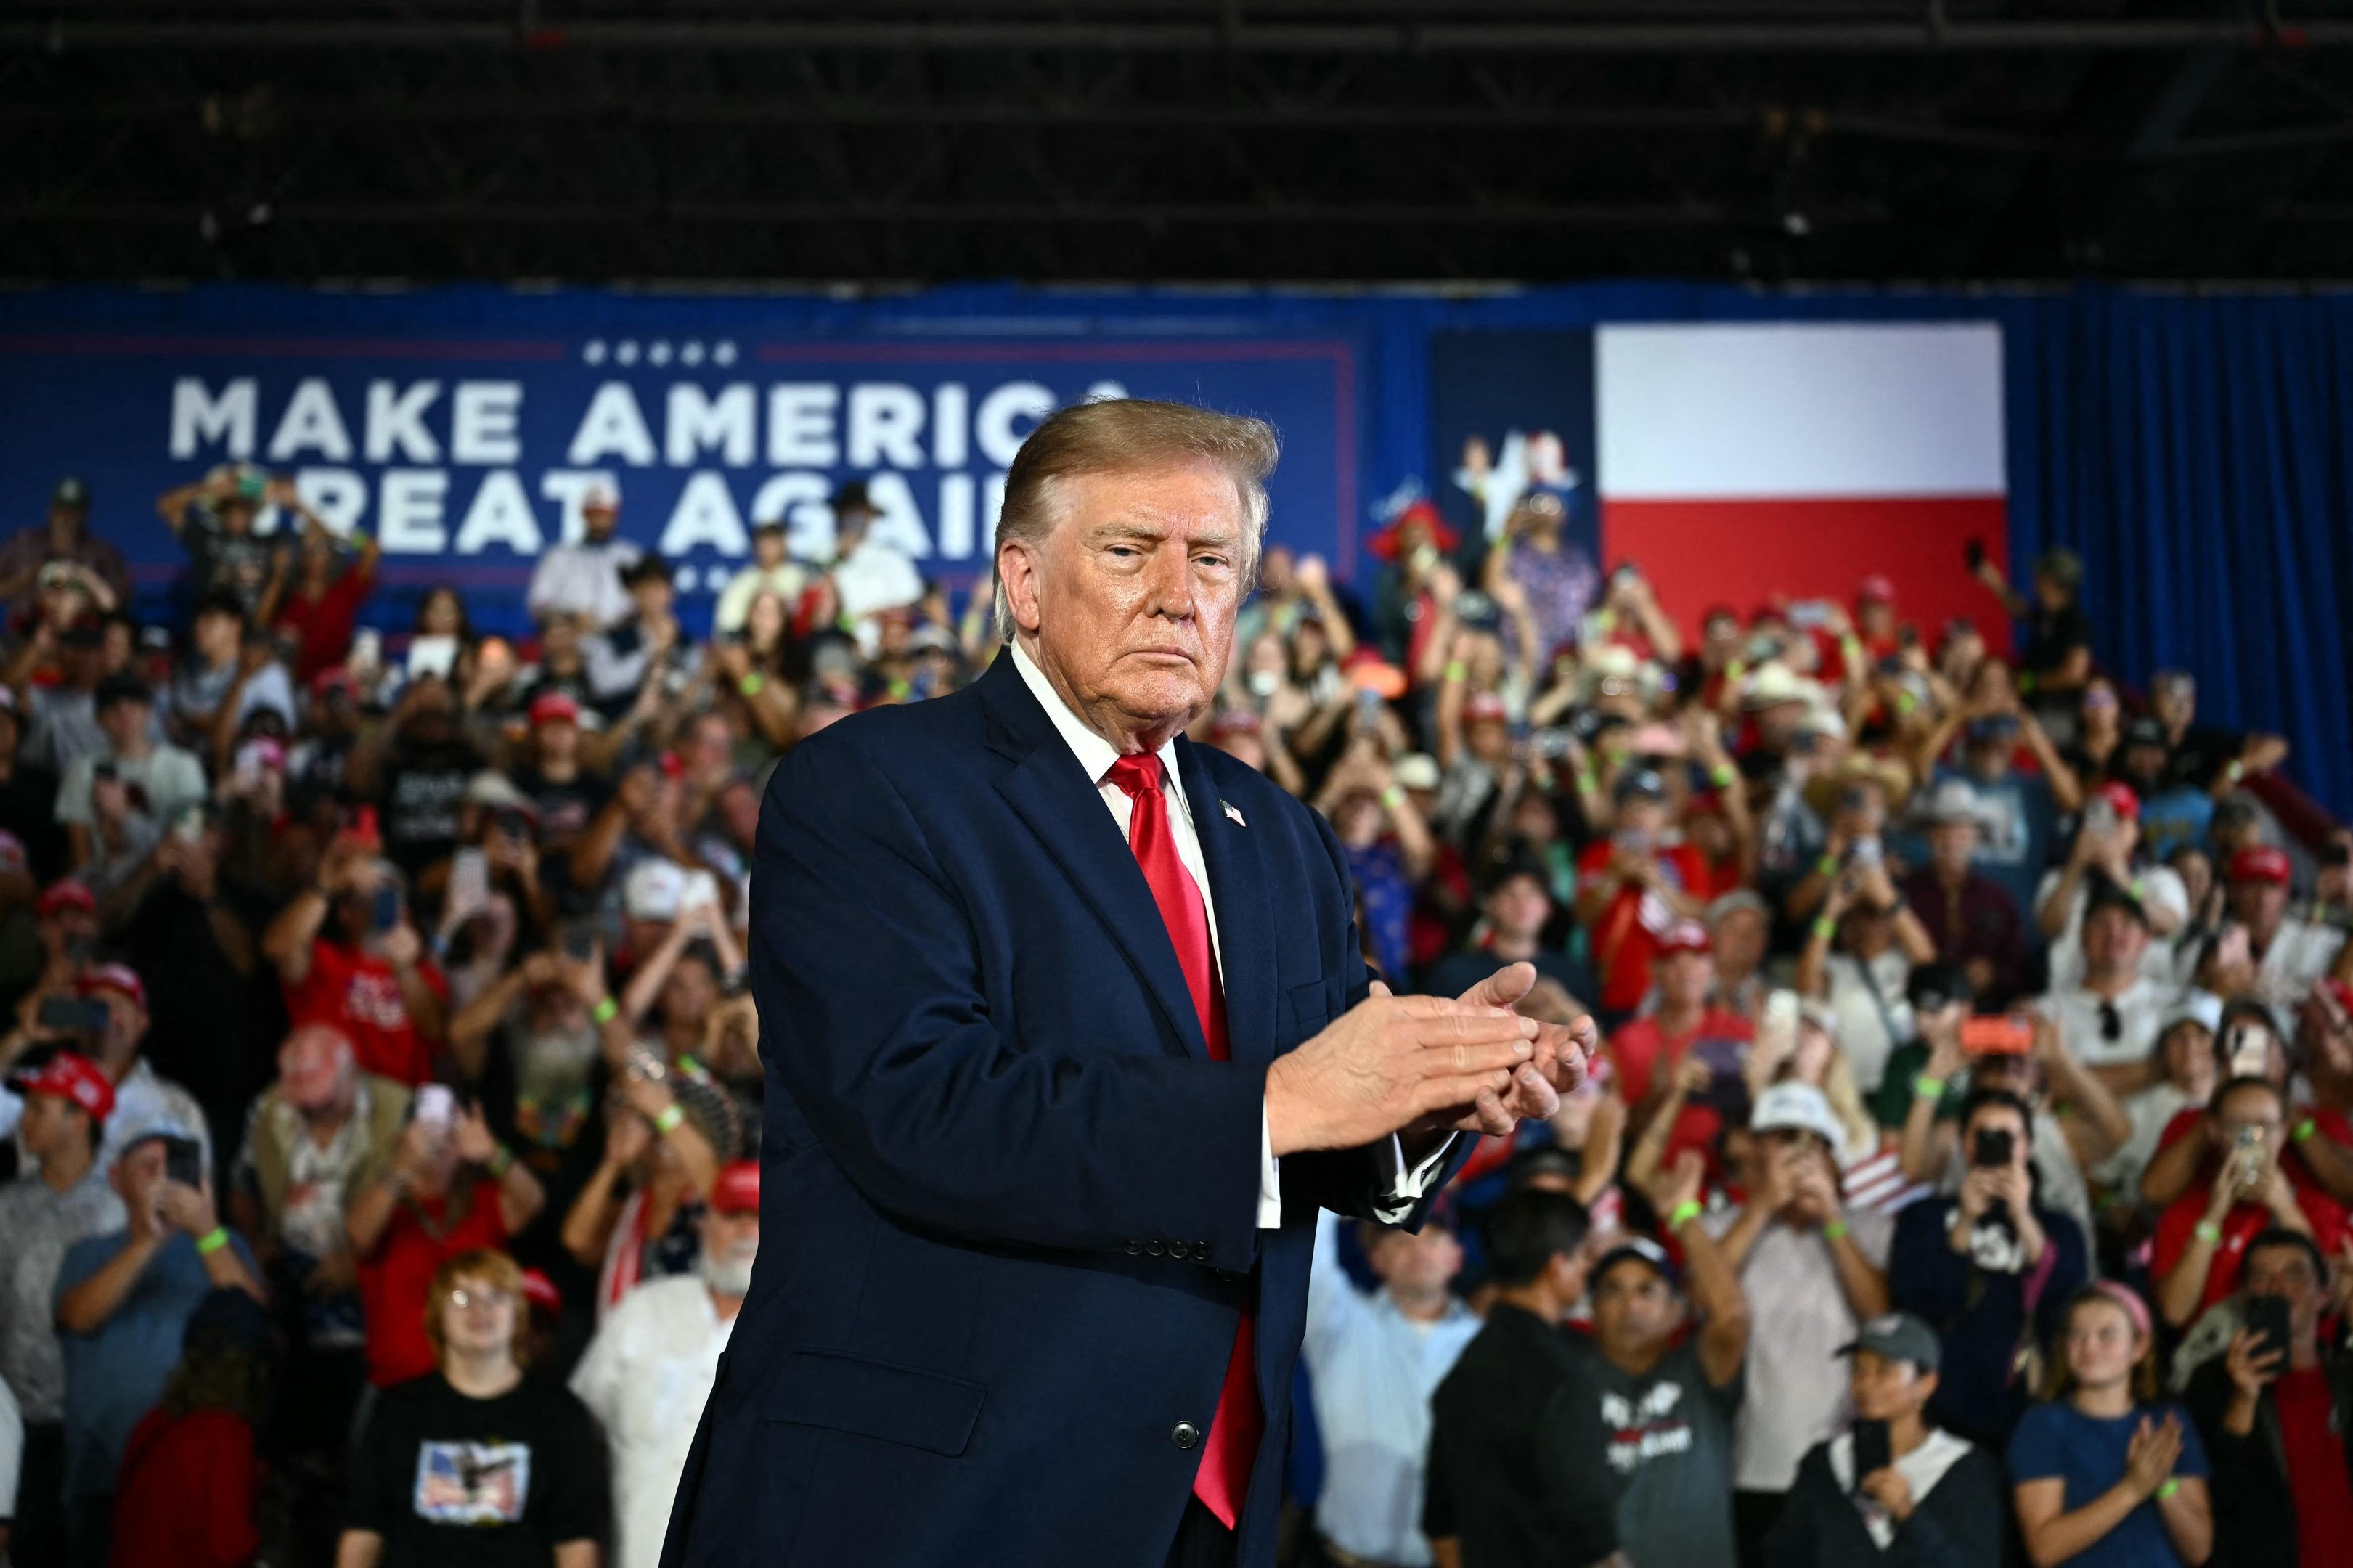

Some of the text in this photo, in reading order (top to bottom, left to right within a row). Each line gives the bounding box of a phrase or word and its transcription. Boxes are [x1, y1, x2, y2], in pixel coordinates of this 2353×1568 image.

[169, 377, 1130, 469] MAKE AMERIC
[250, 468, 619, 556] REAT
